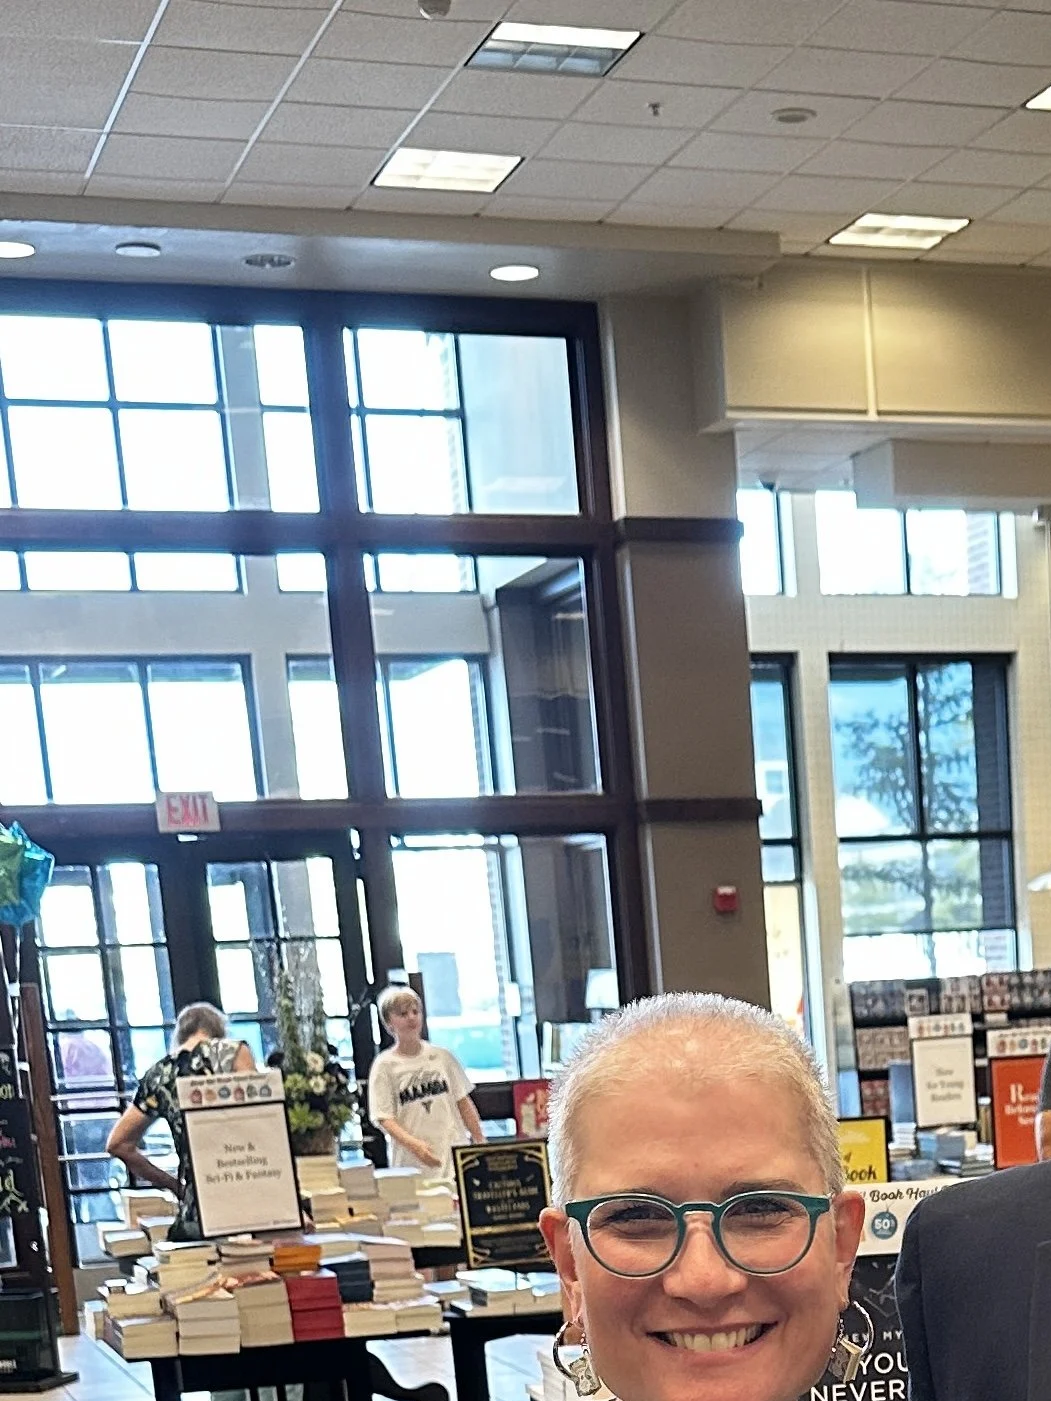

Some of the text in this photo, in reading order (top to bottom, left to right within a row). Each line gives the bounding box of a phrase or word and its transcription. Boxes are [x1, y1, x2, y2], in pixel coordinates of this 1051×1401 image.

[165, 793, 210, 826] EXIT
[223, 1143, 245, 1154] New
[216, 1155, 269, 1169] Bestselling
[206, 1171, 234, 1184] Sci-Fi
[245, 1168, 282, 1182] Fantasy
[869, 1188, 904, 1203] Book
